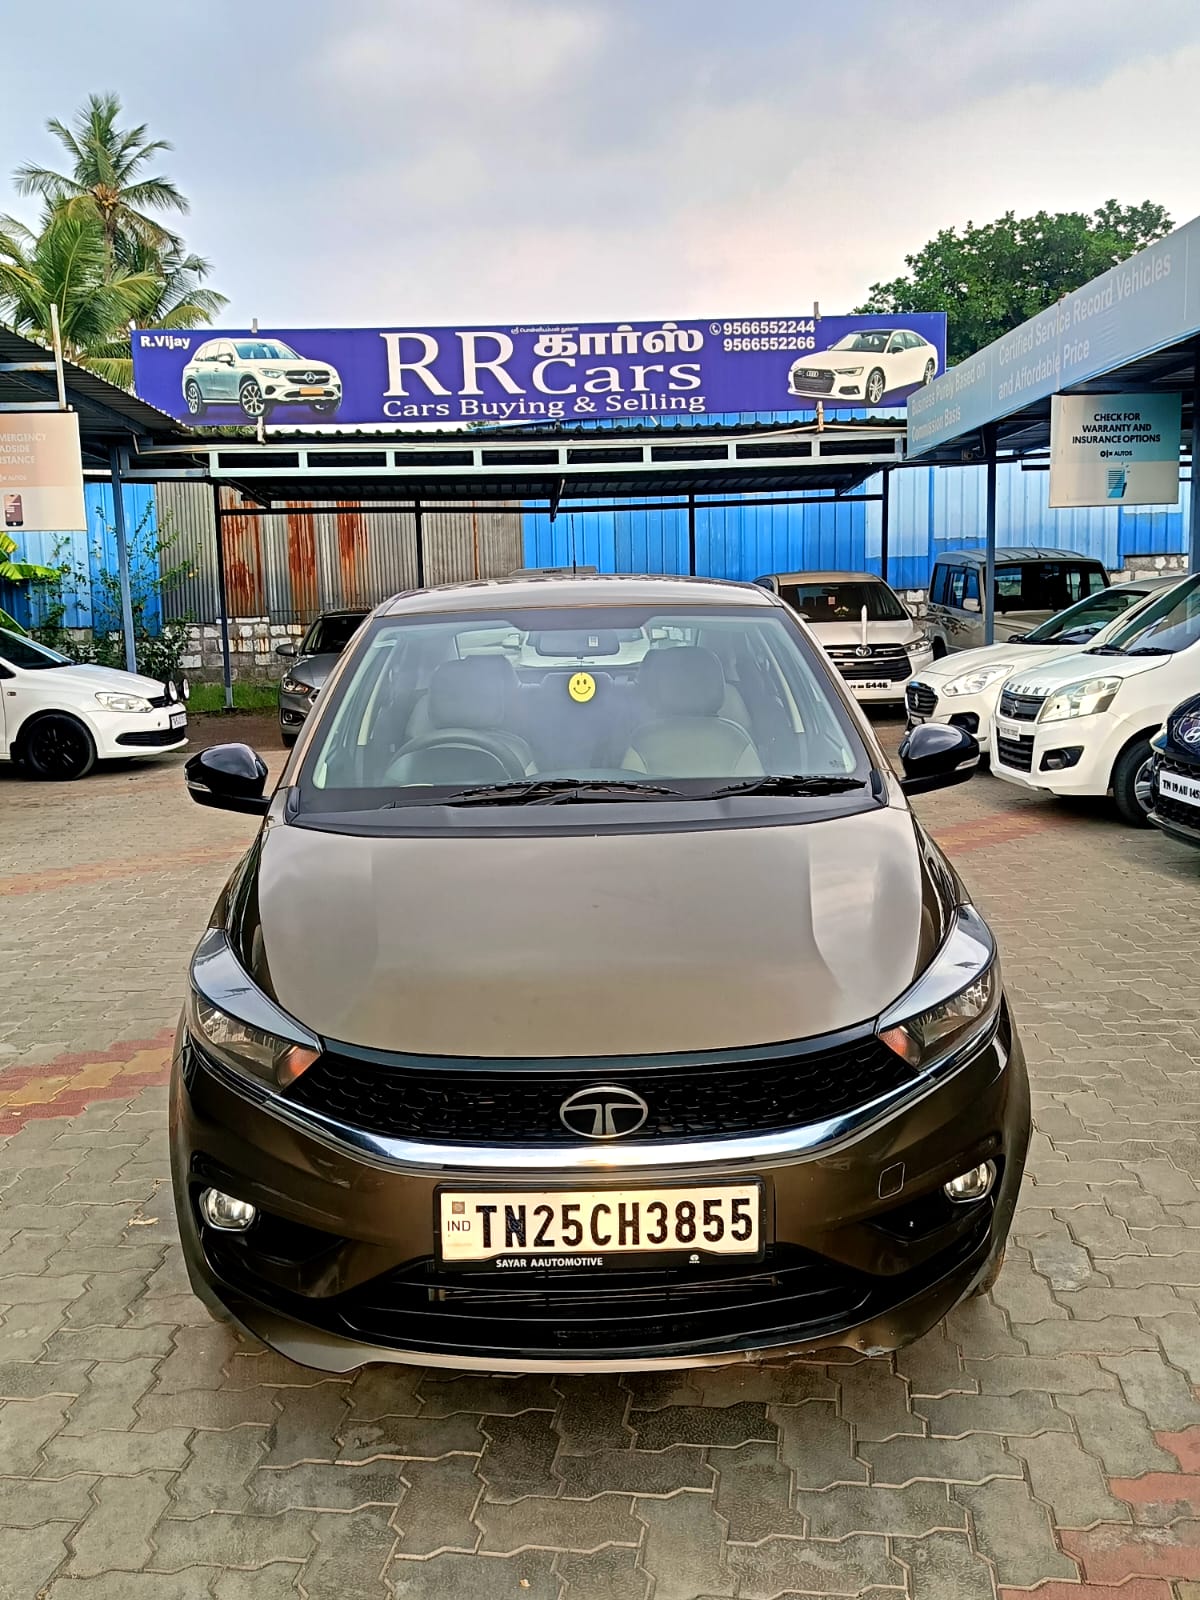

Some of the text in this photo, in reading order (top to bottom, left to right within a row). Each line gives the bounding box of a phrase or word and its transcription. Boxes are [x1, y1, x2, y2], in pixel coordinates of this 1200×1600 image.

[1000, 253, 1172, 366] Certified Service Record Vehicles
[723, 319, 815, 335] 9566552244
[140, 335, 190, 350] R.Vijay
[533, 322, 704, 357] கார்ஸ்
[723, 336, 815, 351] 9566552266
[532, 358, 701, 395] Cars
[956, 362, 975, 392] Based
[977, 362, 986, 379] on
[998, 339, 1090, 400] and Affordable Price
[383, 393, 706, 419] Cars Buying & Selling
[945, 404, 961, 427] Basis
[1094, 412, 1141, 421] CHECK FOR
[1082, 423, 1152, 433] WARRANTY AND
[1072, 434, 1161, 444] INSURANCE OPTIONS
[1162, 779, 1171, 790] TN
[1189, 787, 1200, 800] 145
[447, 1220, 471, 1232] IND
[475, 1198, 753, 1249] TN25CH3855
[496, 1257, 603, 1268] SAYAR AAUTOMOTIVE
